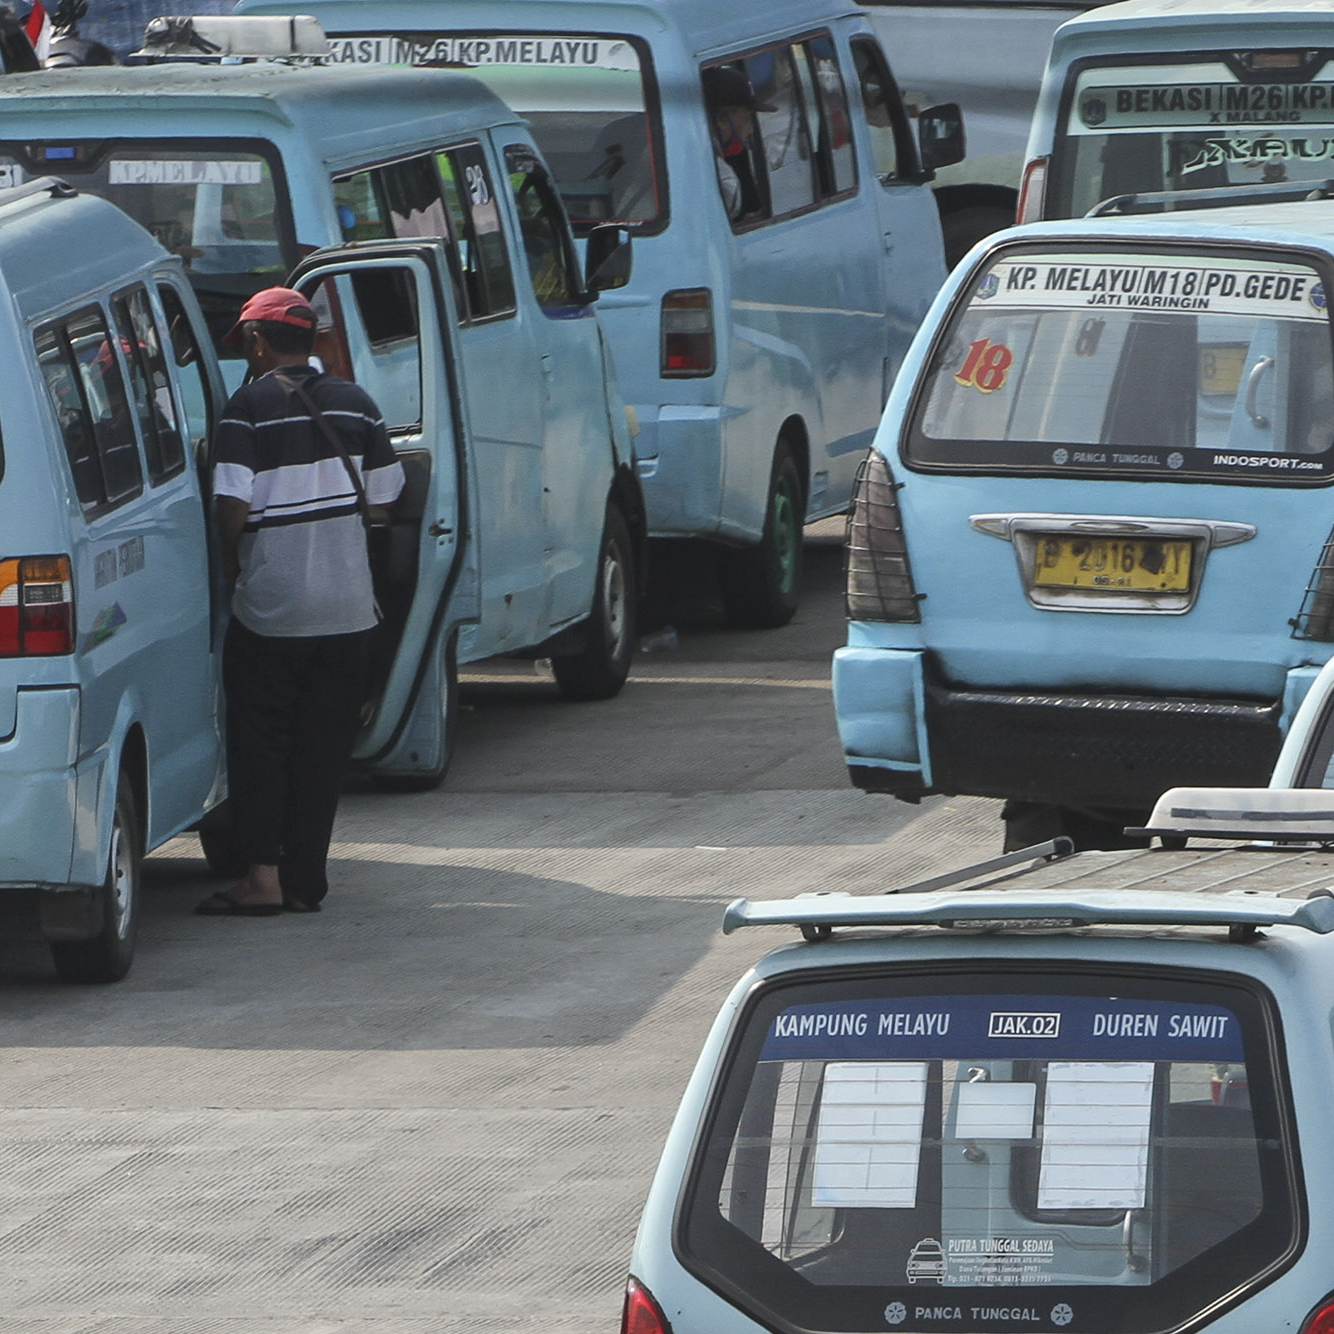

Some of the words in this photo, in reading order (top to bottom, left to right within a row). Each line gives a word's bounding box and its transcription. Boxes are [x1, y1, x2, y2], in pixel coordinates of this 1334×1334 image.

[459, 42, 598, 65] KP.MELAYU
[1117, 87, 1212, 113] BEKASI
[1226, 84, 1282, 111] M26
[1209, 111, 1221, 123] X
[1226, 110, 1301, 123] MALANG
[1006, 266, 1035, 290] KP.
[1045, 267, 1142, 294] MELAYU
[1143, 269, 1197, 296] M18
[1204, 273, 1307, 301] PD.GEDE
[1087, 293, 1121, 305] JATI
[1127, 295, 1209, 309] WARINGIN
[954, 337, 1015, 394] 18
[1112, 453, 1160, 464] TUNGGAL
[775, 1013, 867, 1037] KAMPUNG
[878, 1013, 950, 1036] MELAYU
[994, 1015, 1056, 1035] JAK.02
[1093, 1013, 1159, 1037] DUREN
[1168, 1015, 1228, 1039] SAWIT
[948, 1239, 976, 1252] PUTRA
[980, 1239, 1019, 1252] TUNGGAL
[1022, 1239, 1054, 1252] SEDAYA
[916, 1307, 962, 1319] PANCA
[971, 1307, 1040, 1321] TUNGGAL
